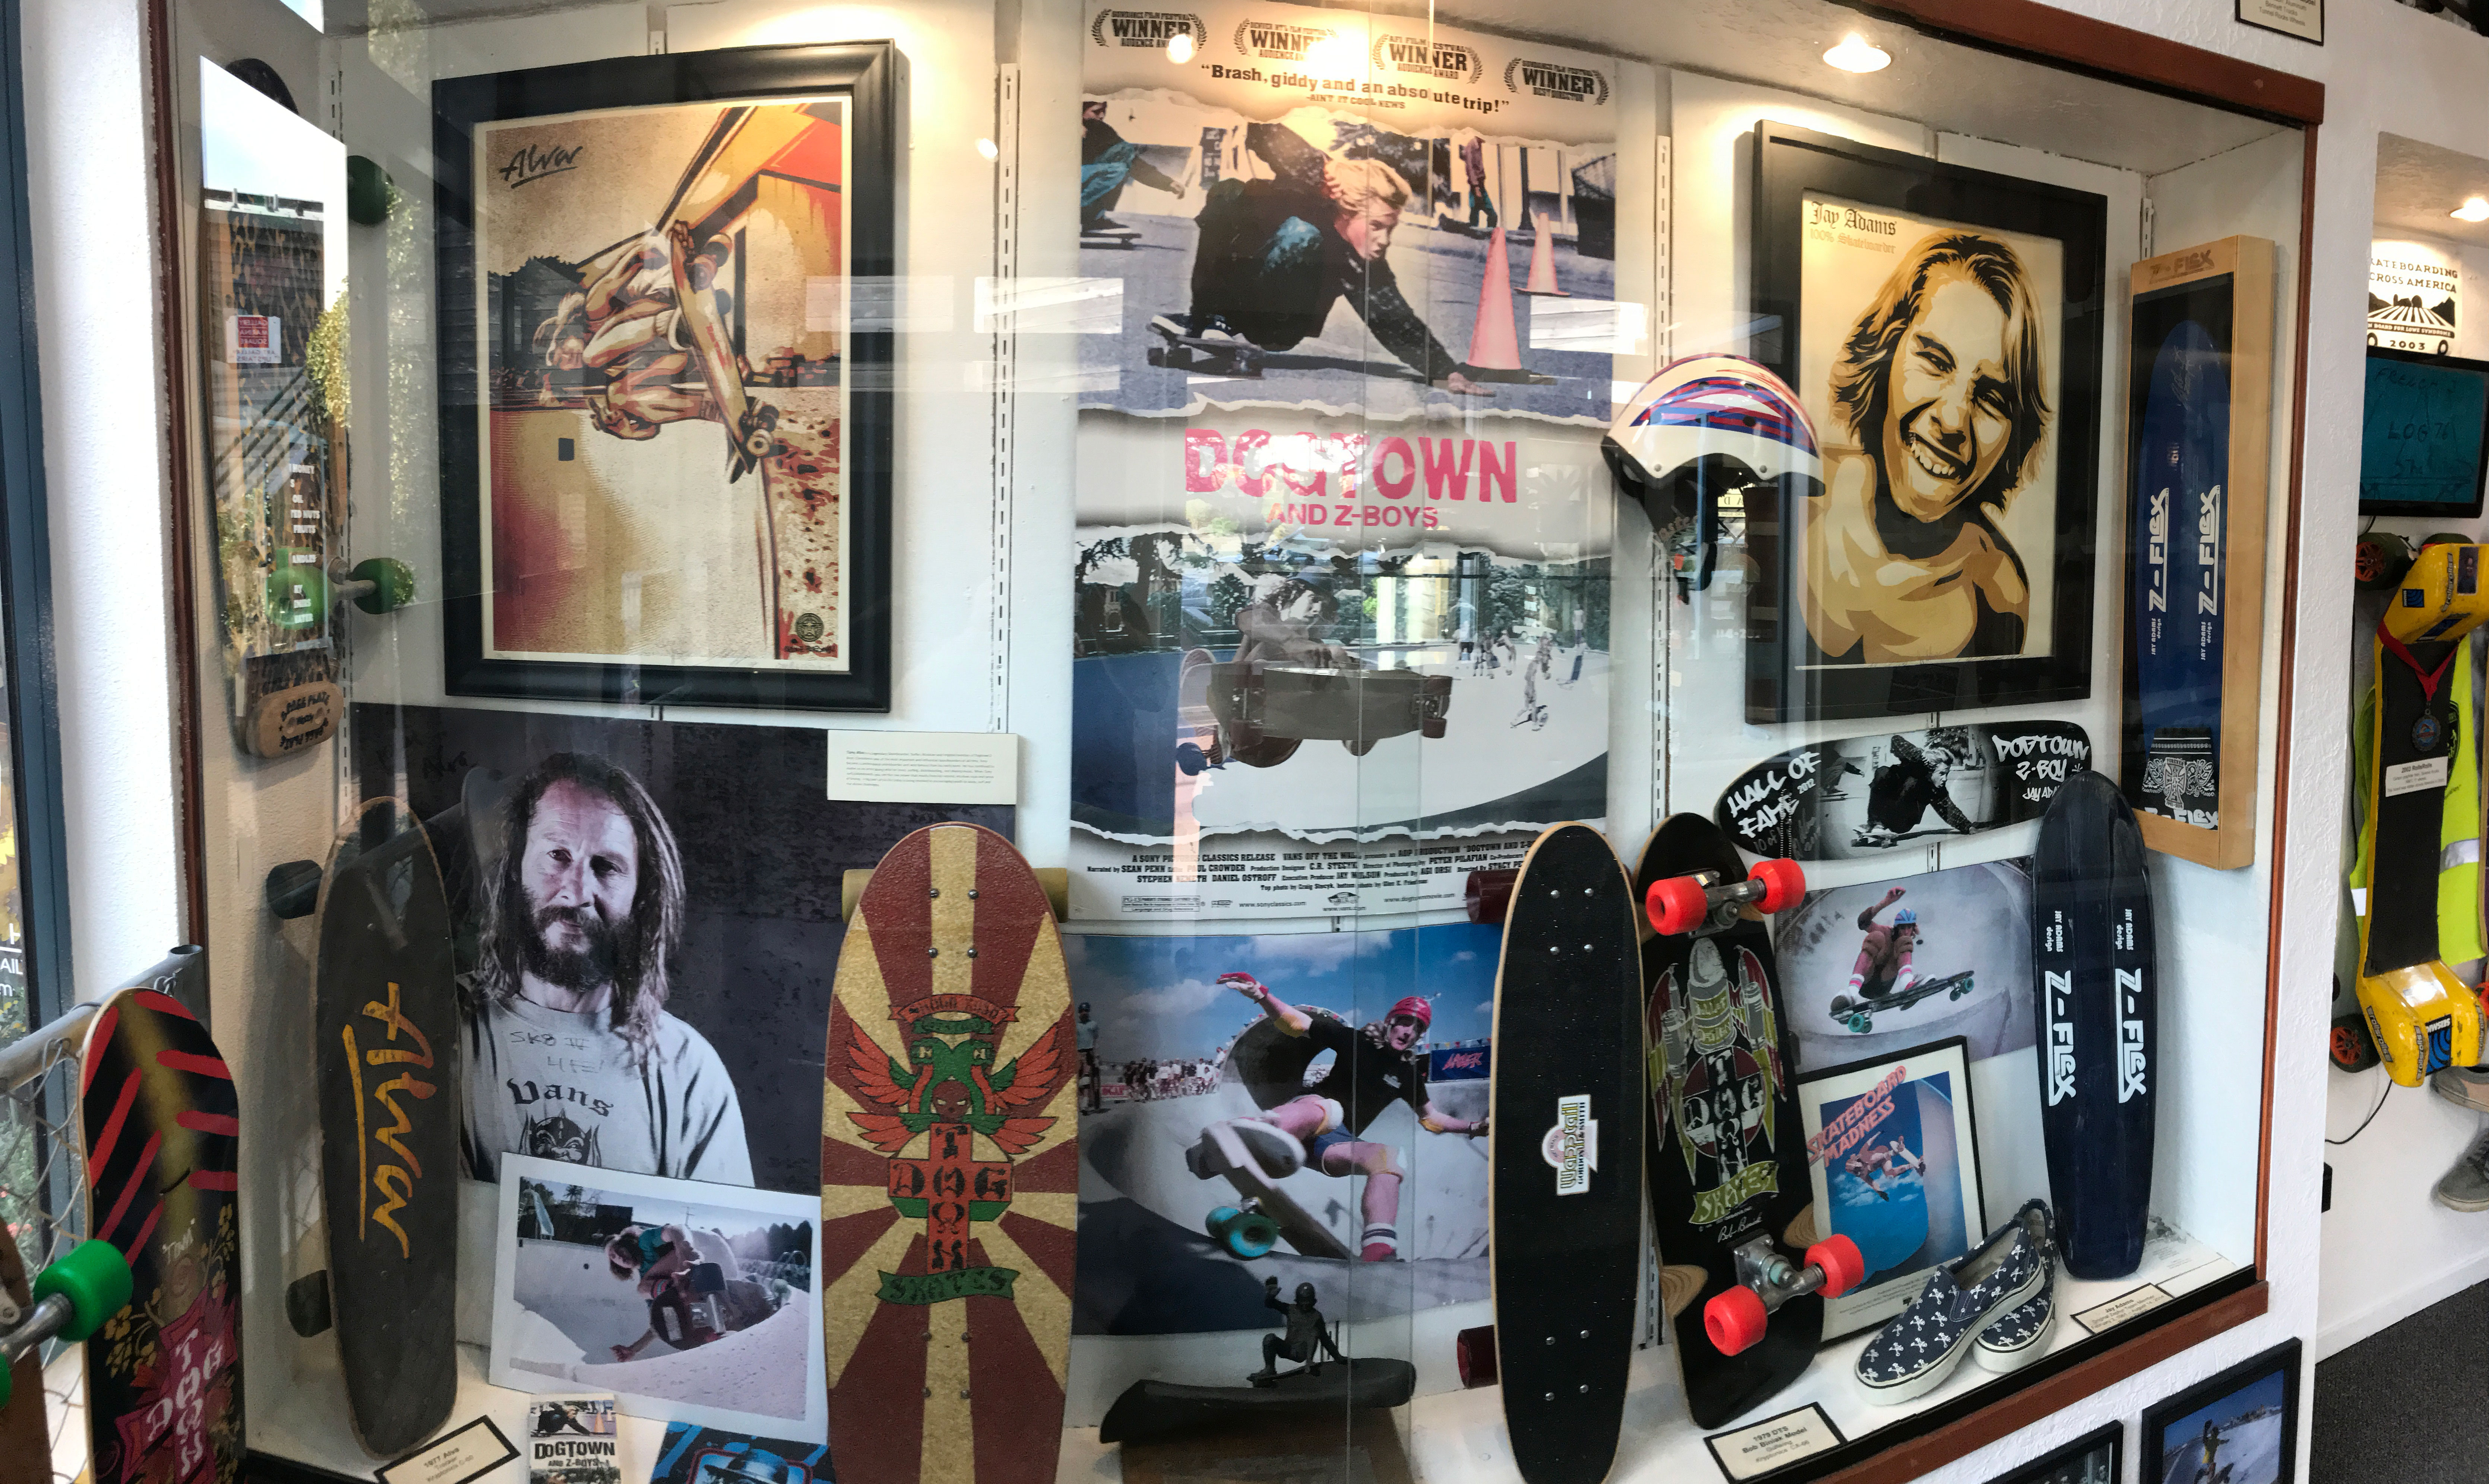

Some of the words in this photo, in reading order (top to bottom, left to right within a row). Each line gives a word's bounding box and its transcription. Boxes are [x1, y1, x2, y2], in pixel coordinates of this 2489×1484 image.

[1111, 19, 1191, 38] WINNER
[1250, 29, 1325, 51] WINNE
[1389, 44, 1467, 71] WINNER
[1271, 72, 1318, 91] giddy
[1322, 79, 1355, 91] and
[1362, 83, 1383, 93] an
[1388, 83, 1460, 104] absoute
[1522, 68, 1595, 94] WINNER
[1810, 201, 1840, 229] Jay
[1844, 209, 1897, 235] Adams
[2407, 279, 2457, 294] AMERICA
[2390, 340, 2425, 351] 2003
[1185, 428, 1517, 503] DOGTOWN
[1267, 502, 1327, 524] AND
[1334, 505, 1439, 527] Z-BOYS
[1788, 751, 1822, 779] OF
[2022, 787, 2041, 802] JAY
[2055, 924, 2063, 953] ADAMS
[2125, 923, 2134, 951] ADAMS
[507, 1078, 614, 1117] Vans
[1807, 1065, 1907, 1156] SKATEBOARD
[1824, 1095, 1895, 1168] MADNESS
[1698, 1163, 1772, 1222] SKATES
[891, 1269, 1008, 1301] SKATES
[534, 1441, 615, 1459] DOGTOWN
